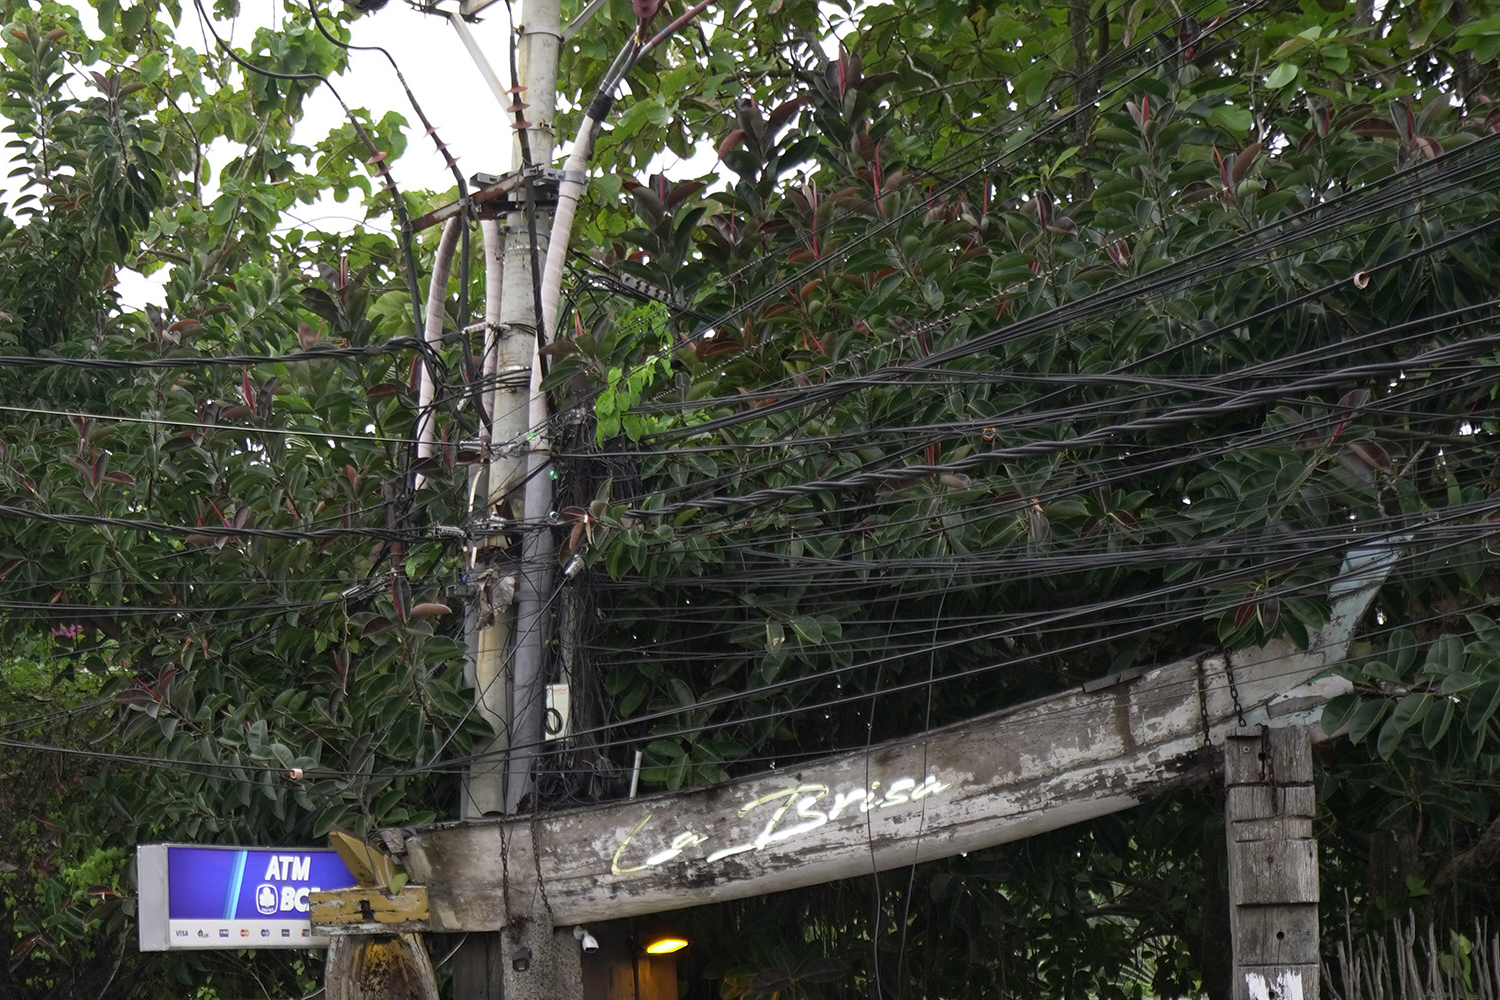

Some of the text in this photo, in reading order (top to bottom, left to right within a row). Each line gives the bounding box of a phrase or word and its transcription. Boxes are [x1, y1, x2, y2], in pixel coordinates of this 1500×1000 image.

[612, 775, 952, 874] La Brisa
[264, 855, 311, 881] ATM
